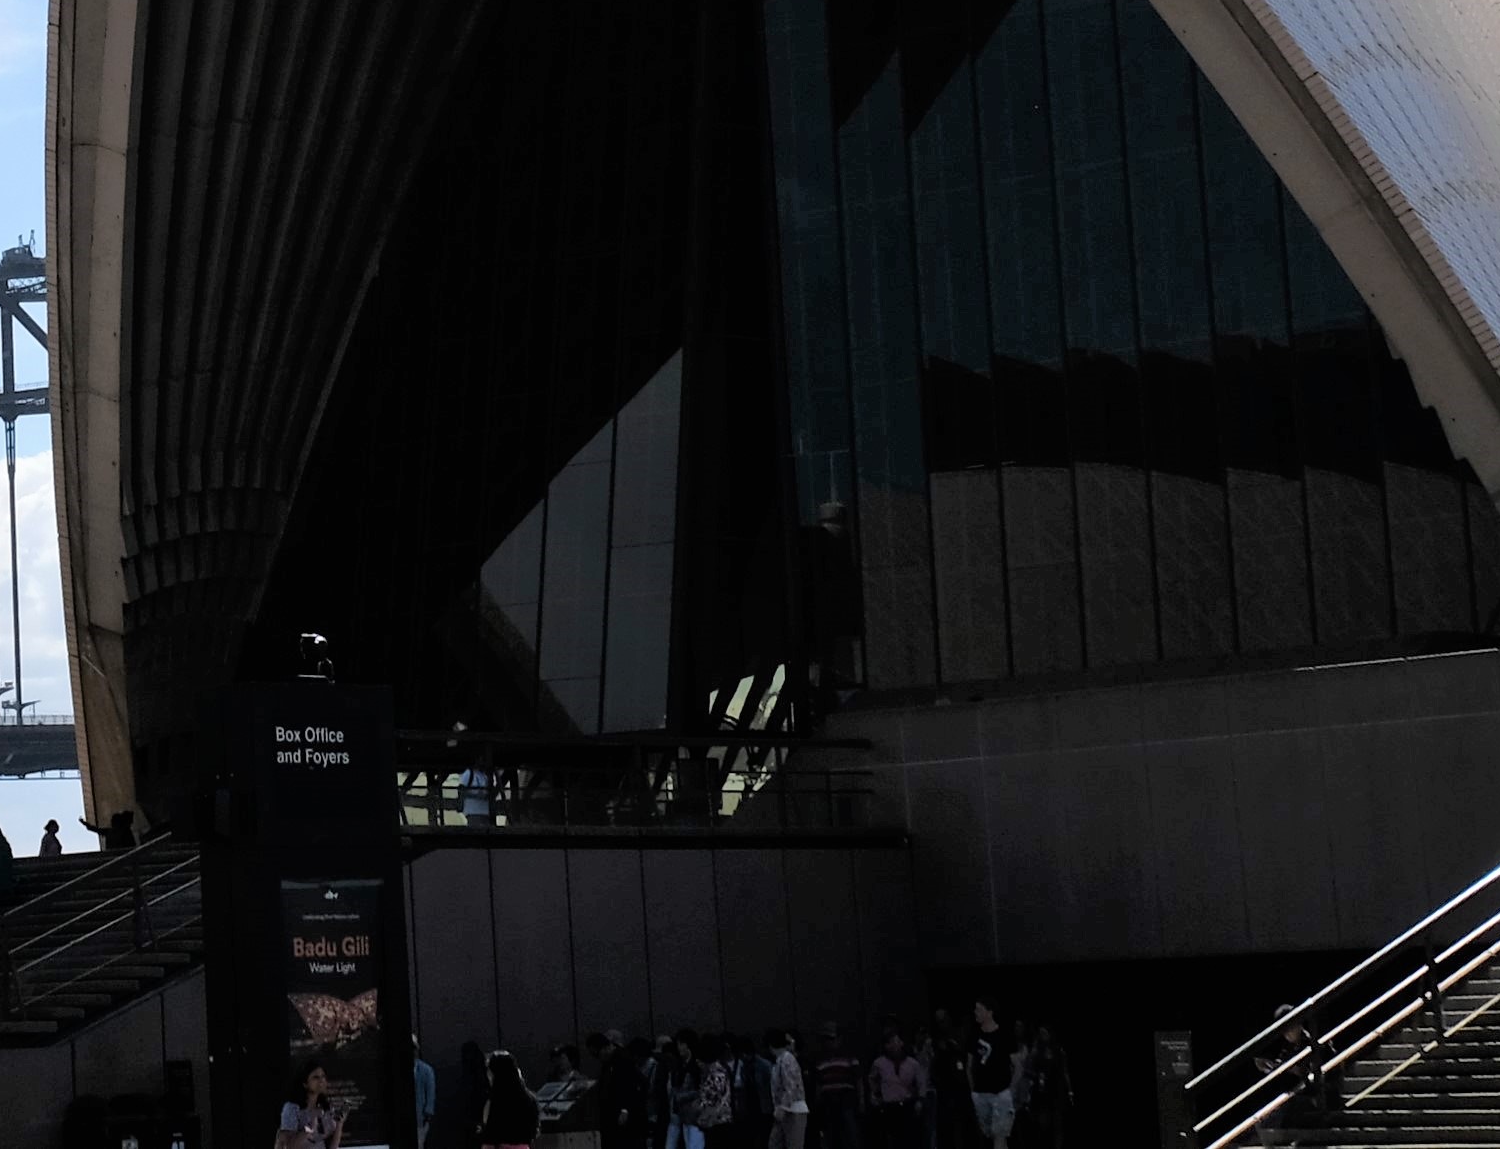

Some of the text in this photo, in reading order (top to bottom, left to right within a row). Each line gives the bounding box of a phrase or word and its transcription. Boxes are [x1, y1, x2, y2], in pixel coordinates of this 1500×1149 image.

[275, 726, 344, 743] Box Office
[276, 747, 349, 768] and Foyers
[293, 935, 369, 957] Badu Gili
[309, 961, 356, 975] Water Light
